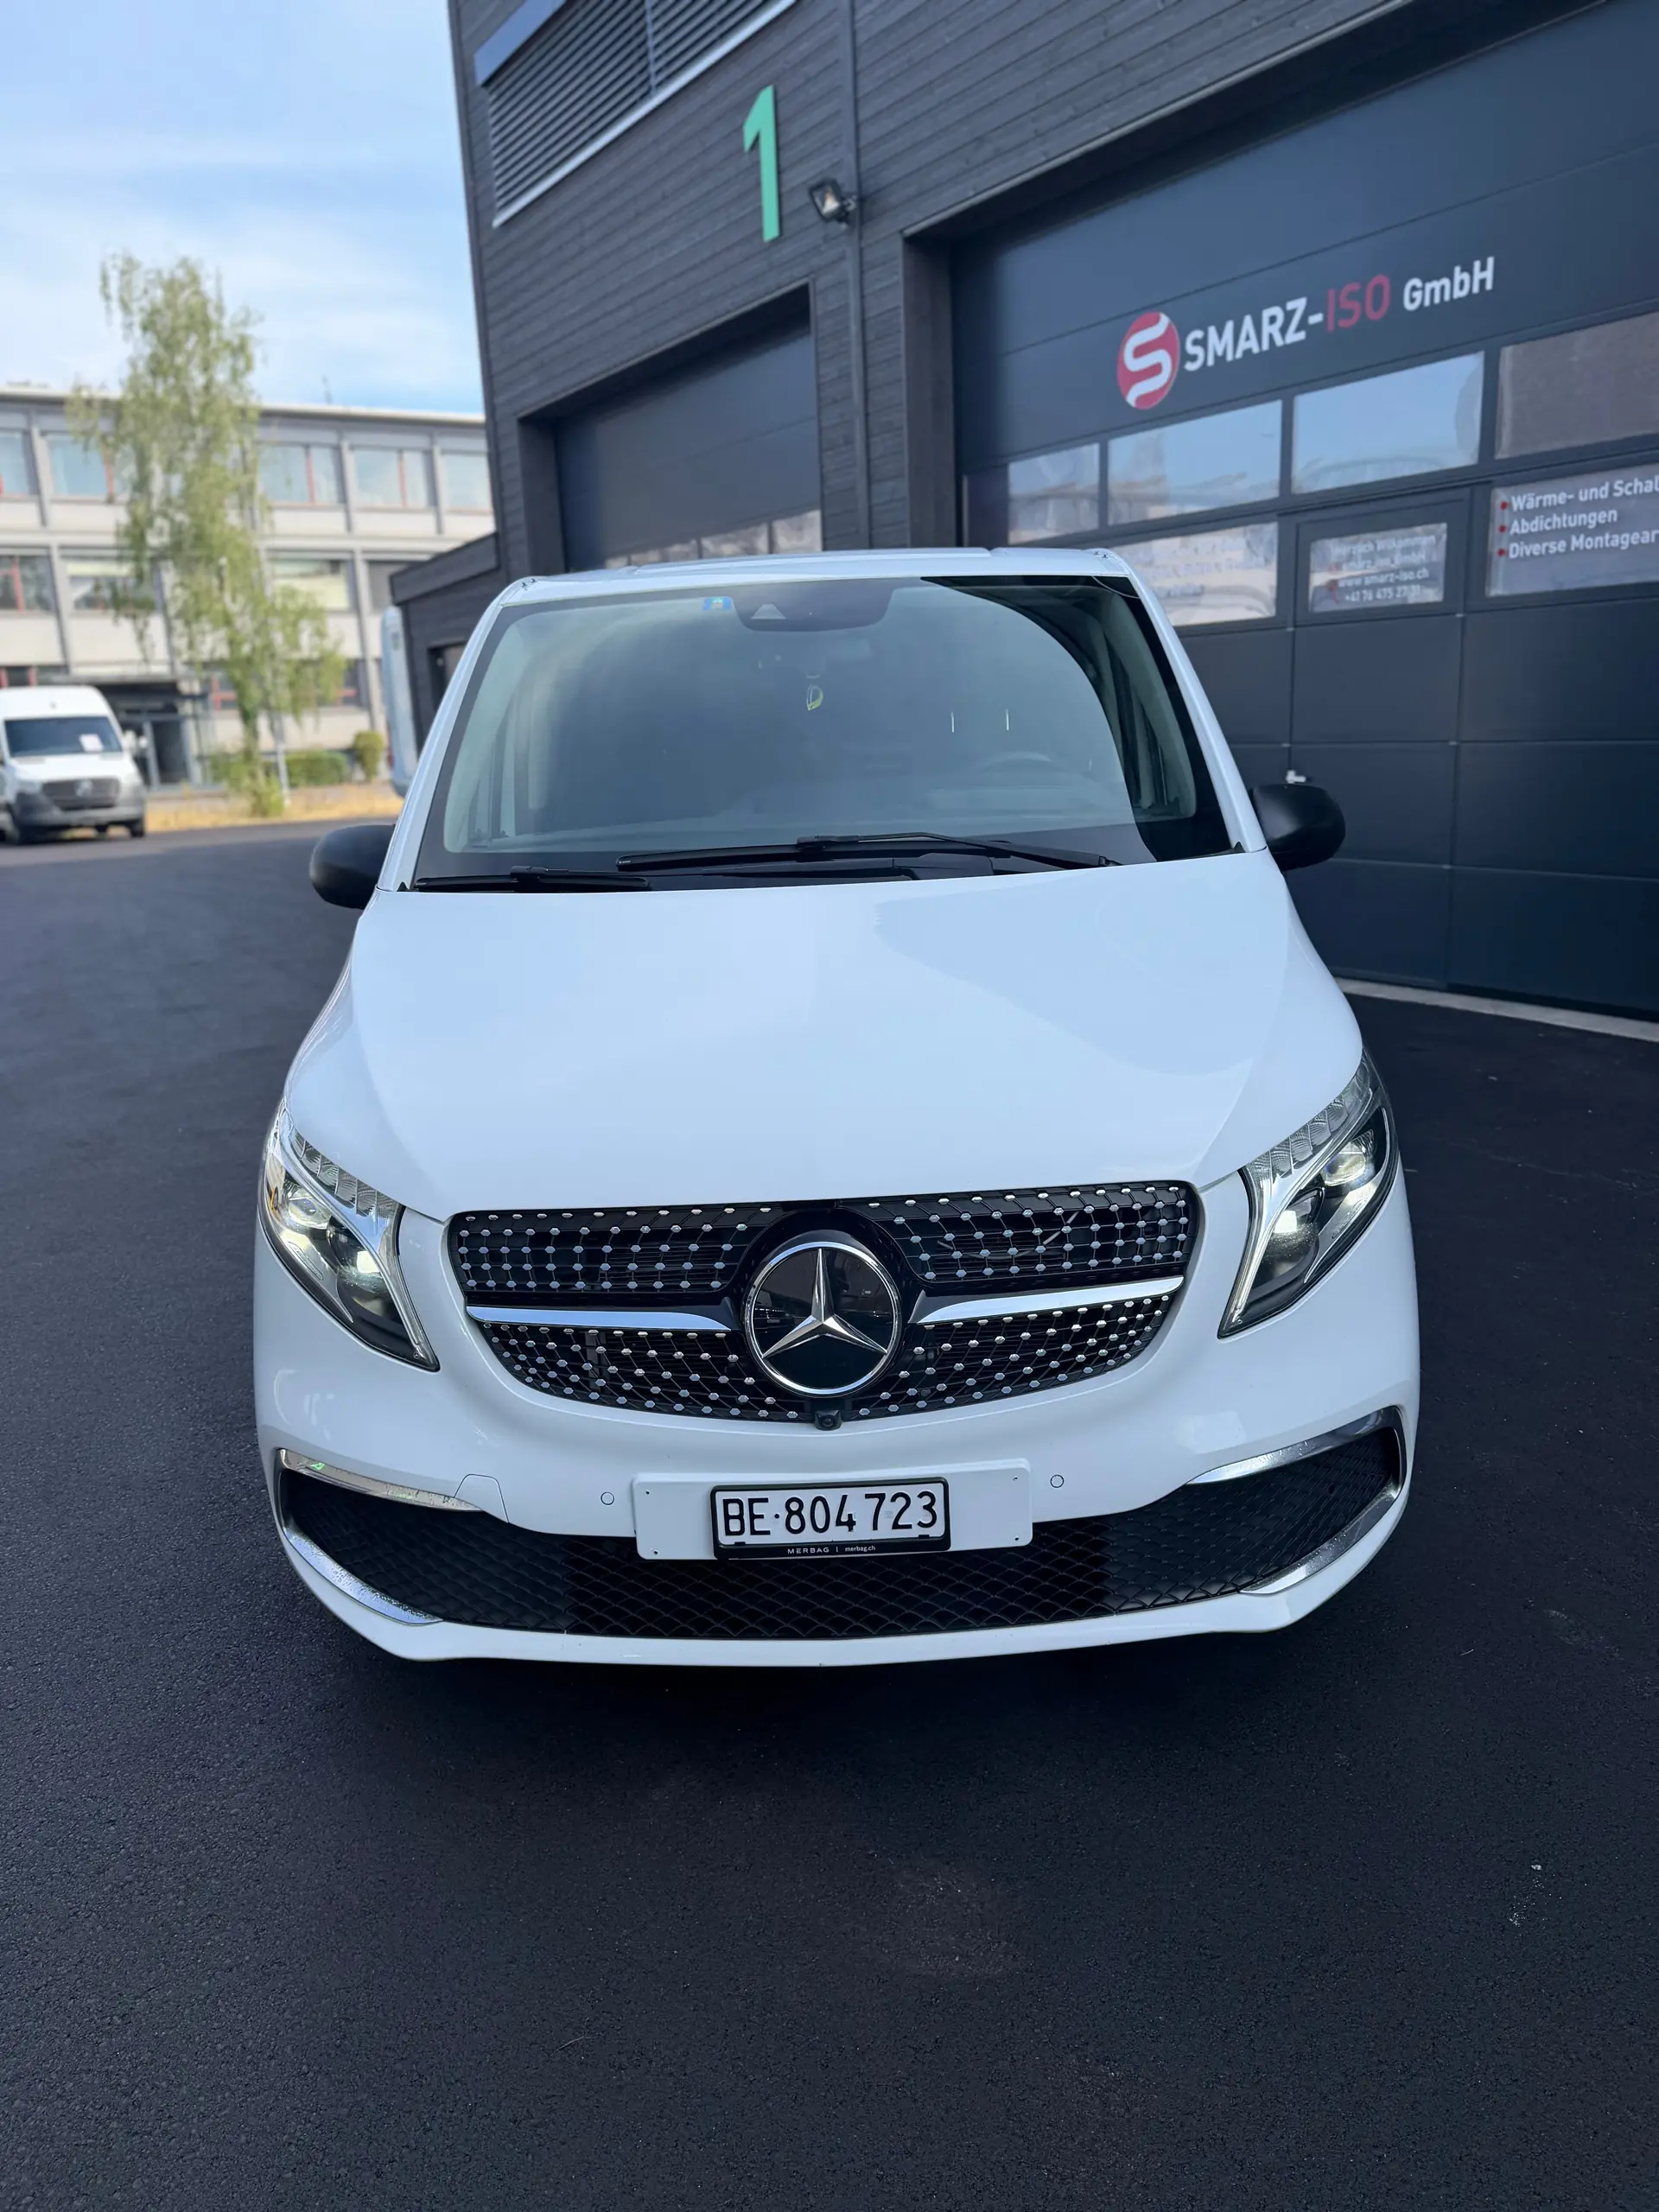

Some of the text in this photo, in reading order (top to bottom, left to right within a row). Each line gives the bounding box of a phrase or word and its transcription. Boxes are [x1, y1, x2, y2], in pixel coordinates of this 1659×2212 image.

[743, 84, 779, 242] 1
[1184, 256, 1495, 372] SMARZ-ISO GmbH
[1510, 491, 1575, 512] Wärme-
[1579, 481, 1610, 502] und
[1510, 509, 1618, 536] Abdichtungen
[1508, 529, 1659, 559] Diverse Montagear
